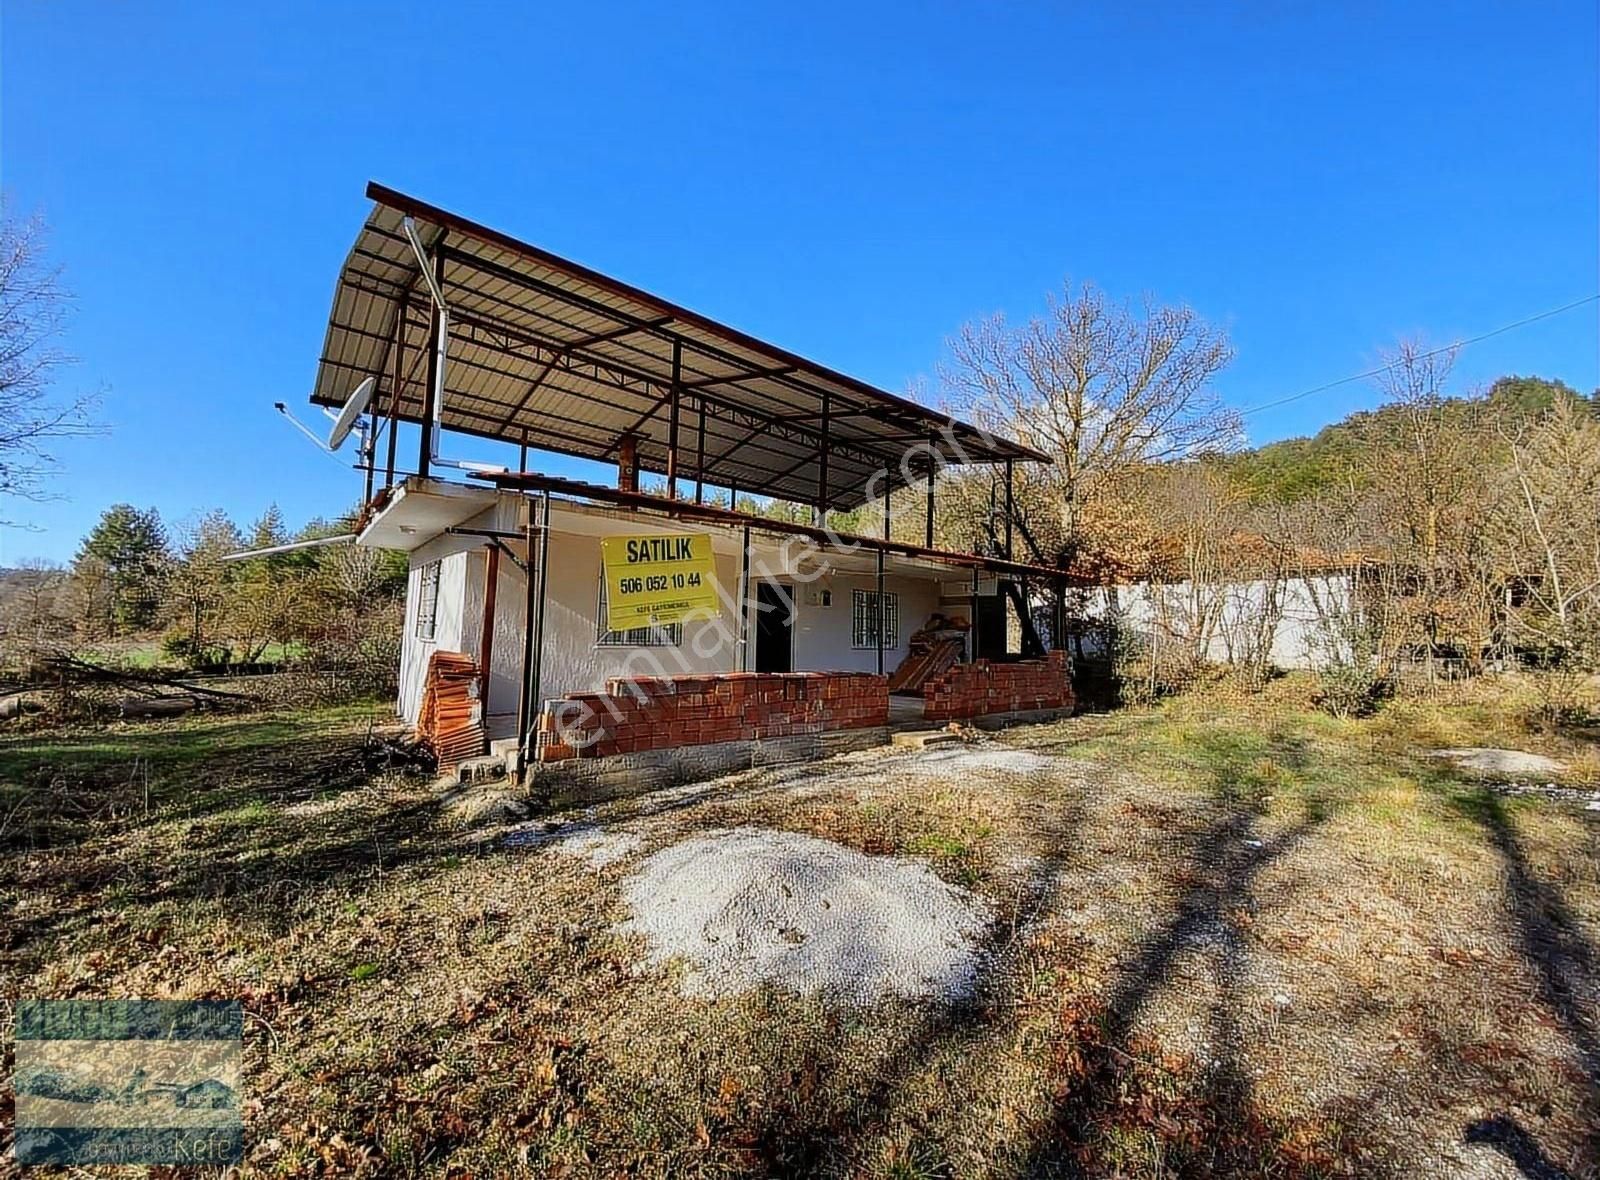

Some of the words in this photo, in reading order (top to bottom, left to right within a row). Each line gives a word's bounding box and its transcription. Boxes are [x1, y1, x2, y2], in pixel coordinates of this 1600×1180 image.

[627, 538, 692, 563] SATILIK
[620, 578, 643, 594] 506
[646, 575, 667, 591] 052
[672, 573, 685, 589] 10
[688, 572, 701, 587] 44
